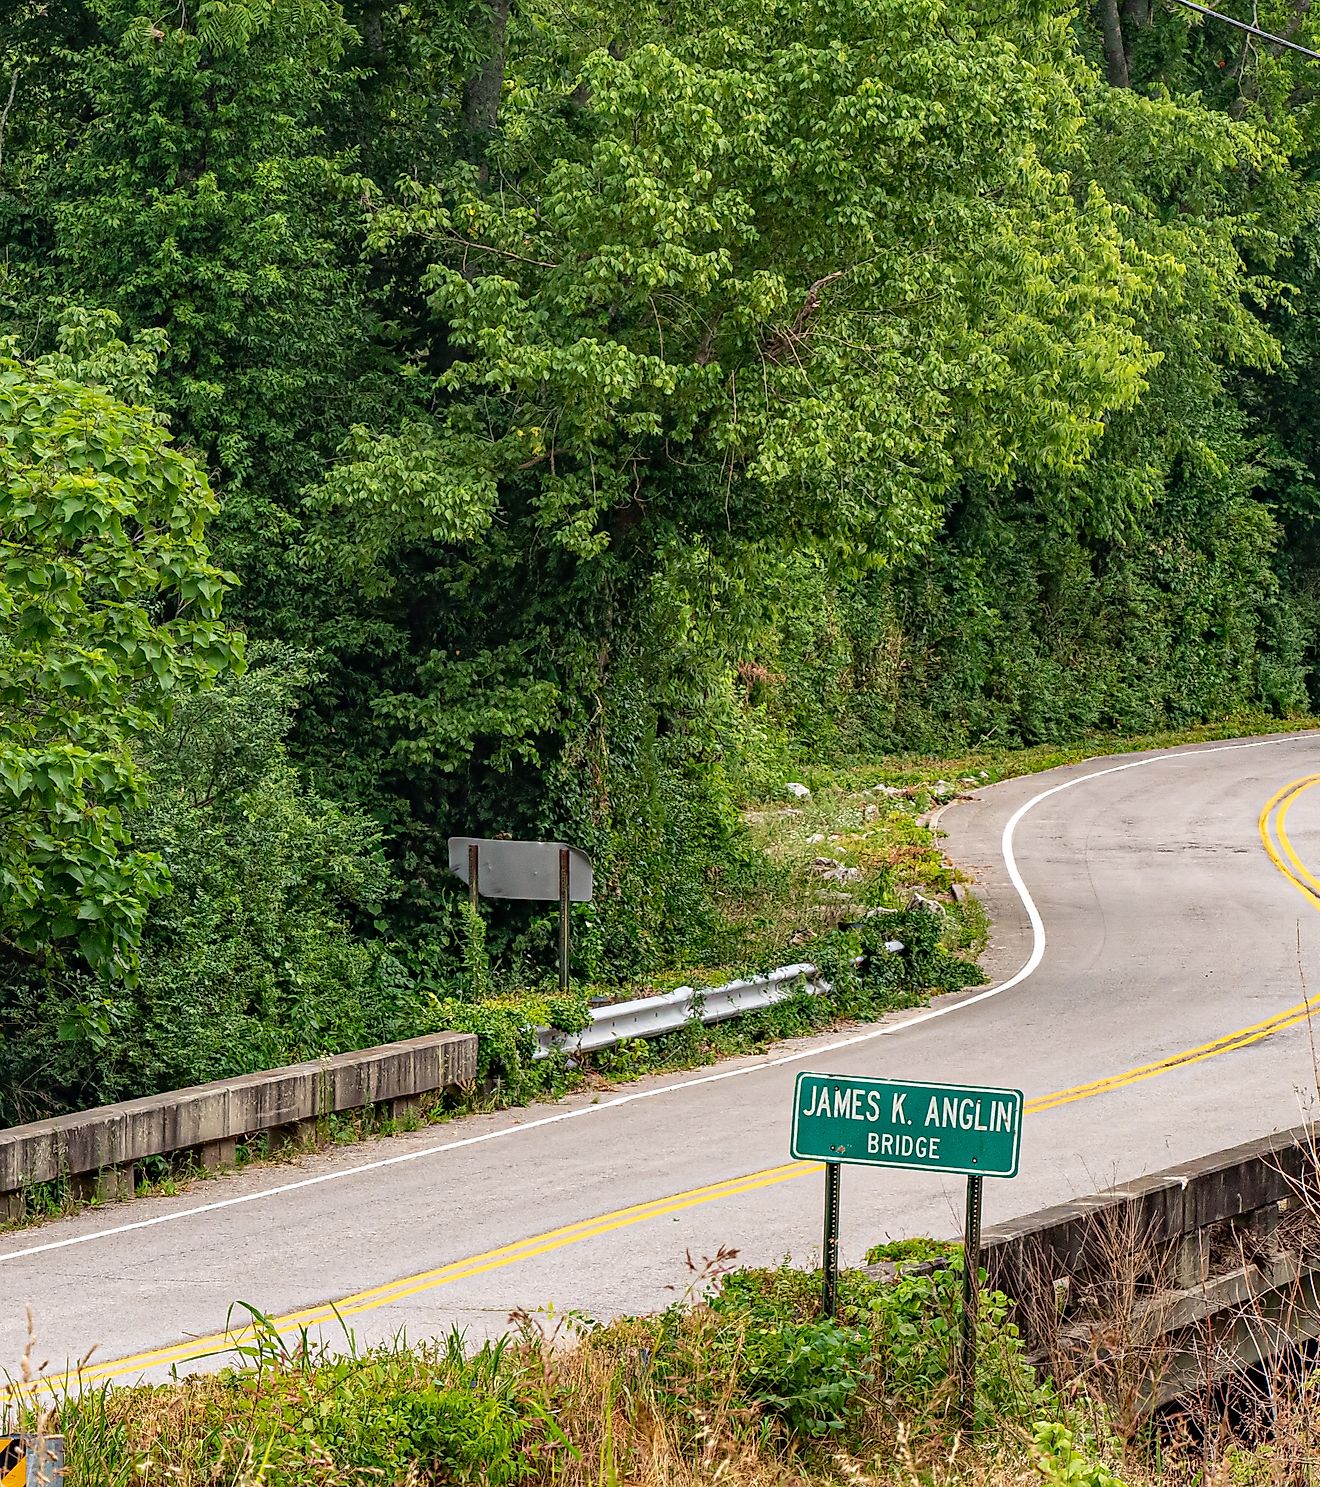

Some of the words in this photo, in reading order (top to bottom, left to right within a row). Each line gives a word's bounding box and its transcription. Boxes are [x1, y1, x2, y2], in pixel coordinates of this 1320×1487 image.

[803, 1085, 881, 1122] JAMES
[891, 1092, 913, 1126] K.
[924, 1096, 1013, 1133] ANGLIN
[867, 1132, 941, 1159] BRIDGE
